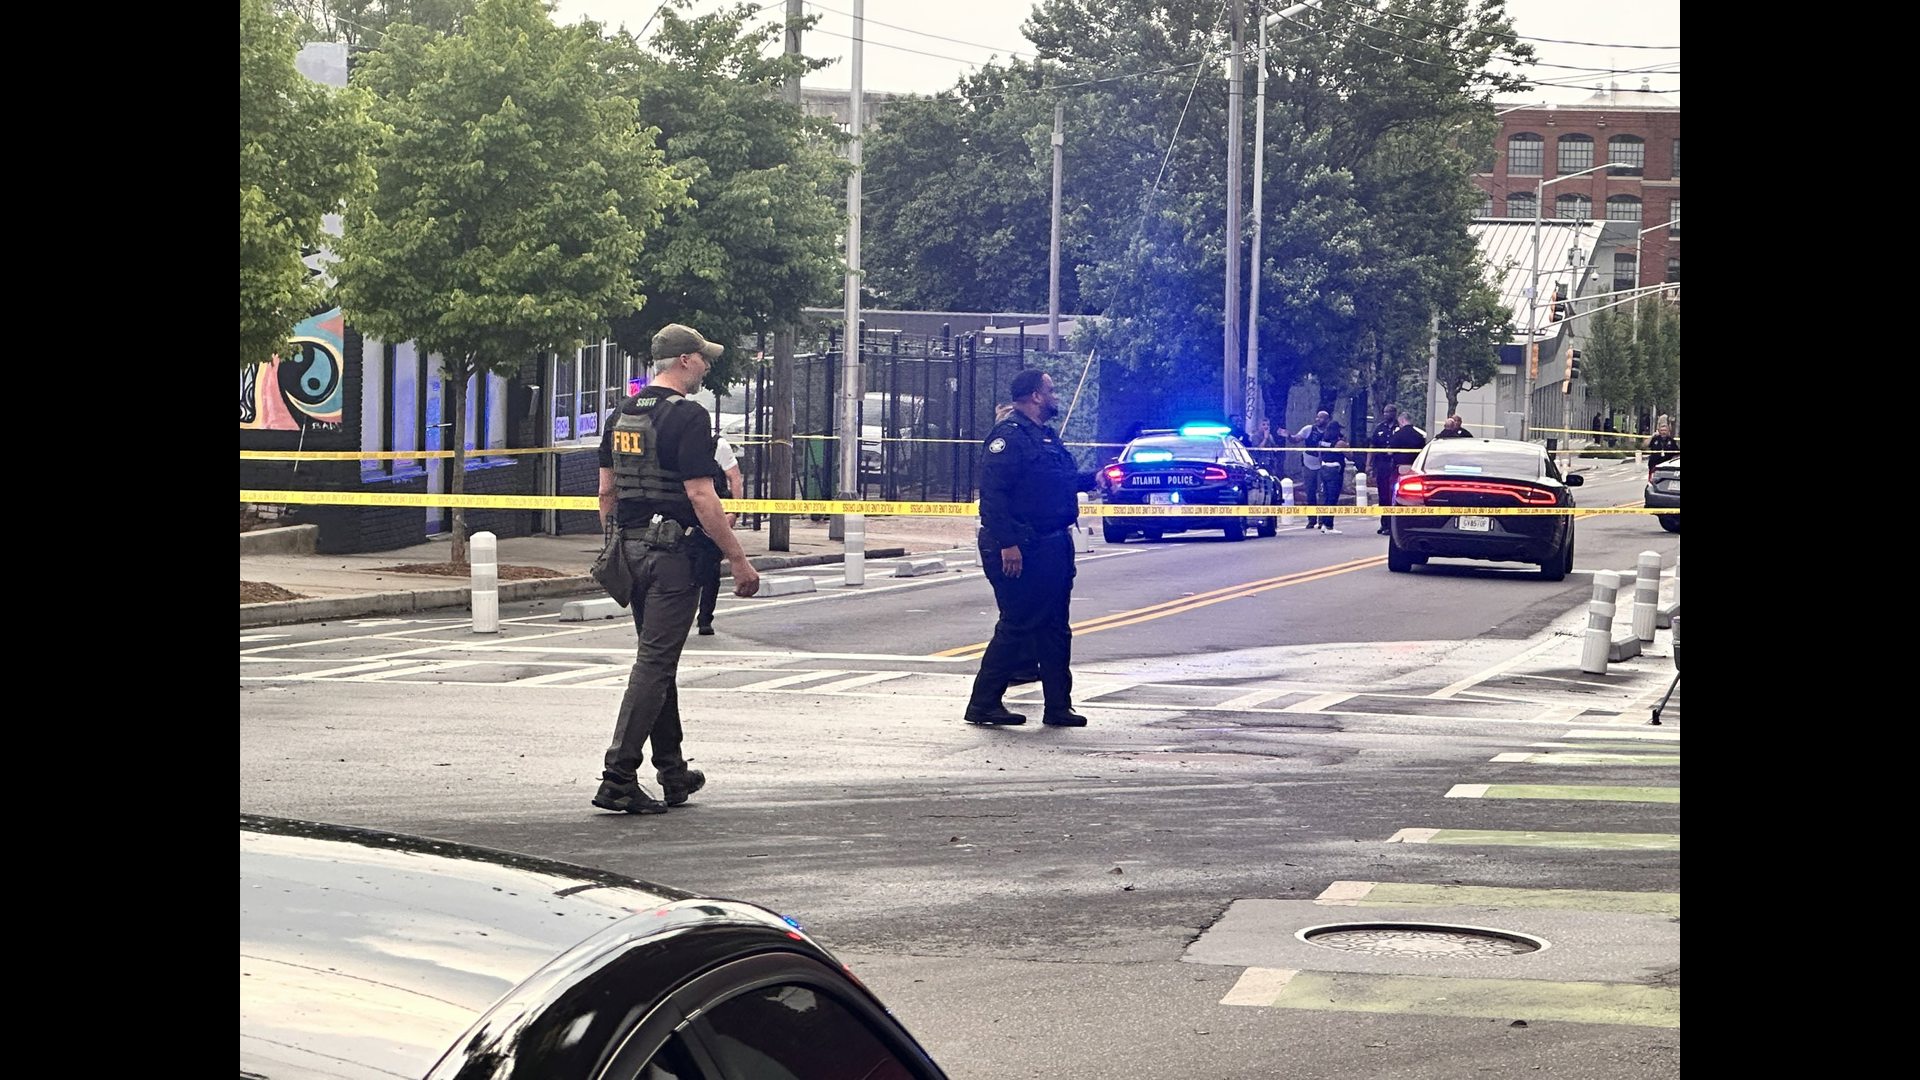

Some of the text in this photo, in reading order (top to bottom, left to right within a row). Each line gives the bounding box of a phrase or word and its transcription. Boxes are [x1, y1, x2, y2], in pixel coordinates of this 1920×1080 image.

[580, 415, 596, 432] WINGS
[613, 430, 642, 454] FBI
[1132, 476, 1193, 485] ATLANTA POLICE
[775, 503, 788, 512] CROSS
[804, 503, 812, 512] LINE
[813, 503, 826, 512] POLICE
[843, 504, 855, 512] CROSS
[865, 504, 870, 512] DO
[871, 504, 880, 512] LINE
[881, 504, 894, 512] POLICE
[910, 505, 923, 513] CROSS
[933, 505, 938, 513] DO
[939, 505, 947, 513] LINE
[948, 505, 962, 513] POLICE
